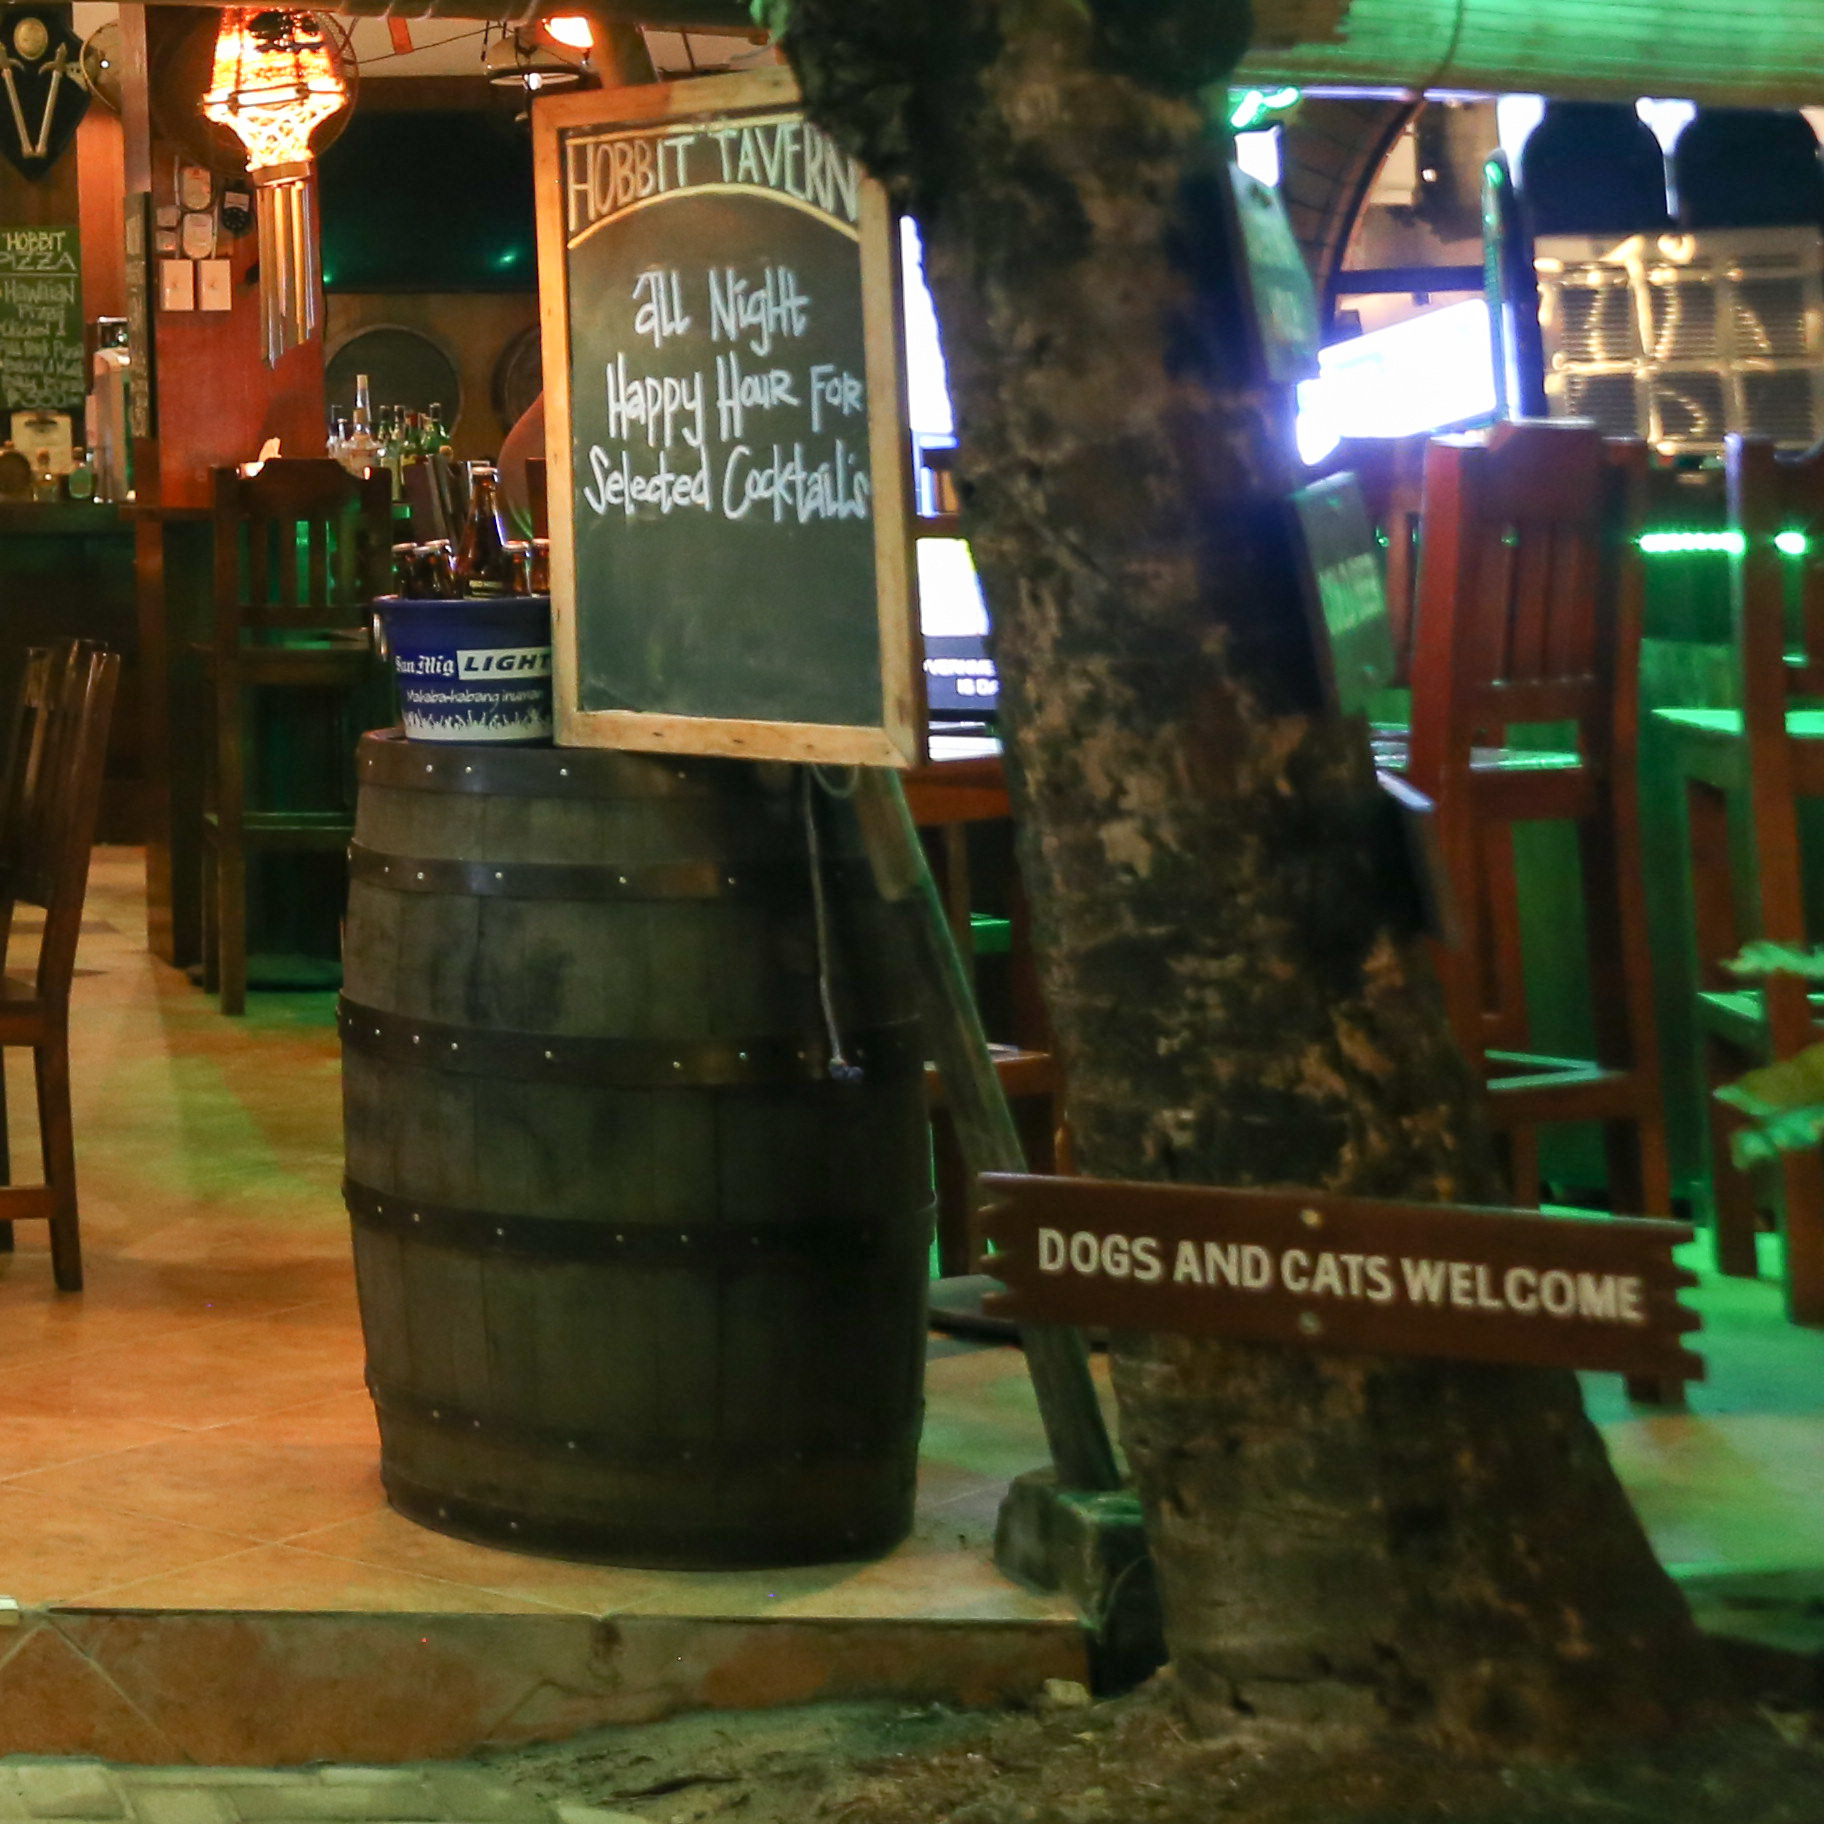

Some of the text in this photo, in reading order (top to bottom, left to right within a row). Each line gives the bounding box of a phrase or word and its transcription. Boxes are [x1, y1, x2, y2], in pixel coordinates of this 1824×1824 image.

[566, 120, 860, 231] HOBBIT TAVERN
[709, 265, 809, 357] Night
[607, 351, 704, 447] Happy
[584, 442, 712, 515] Selected
[394, 653, 552, 676] San Mig LIGHT
[1037, 1226, 1646, 1323] DOGS AND CATS WELCOME
